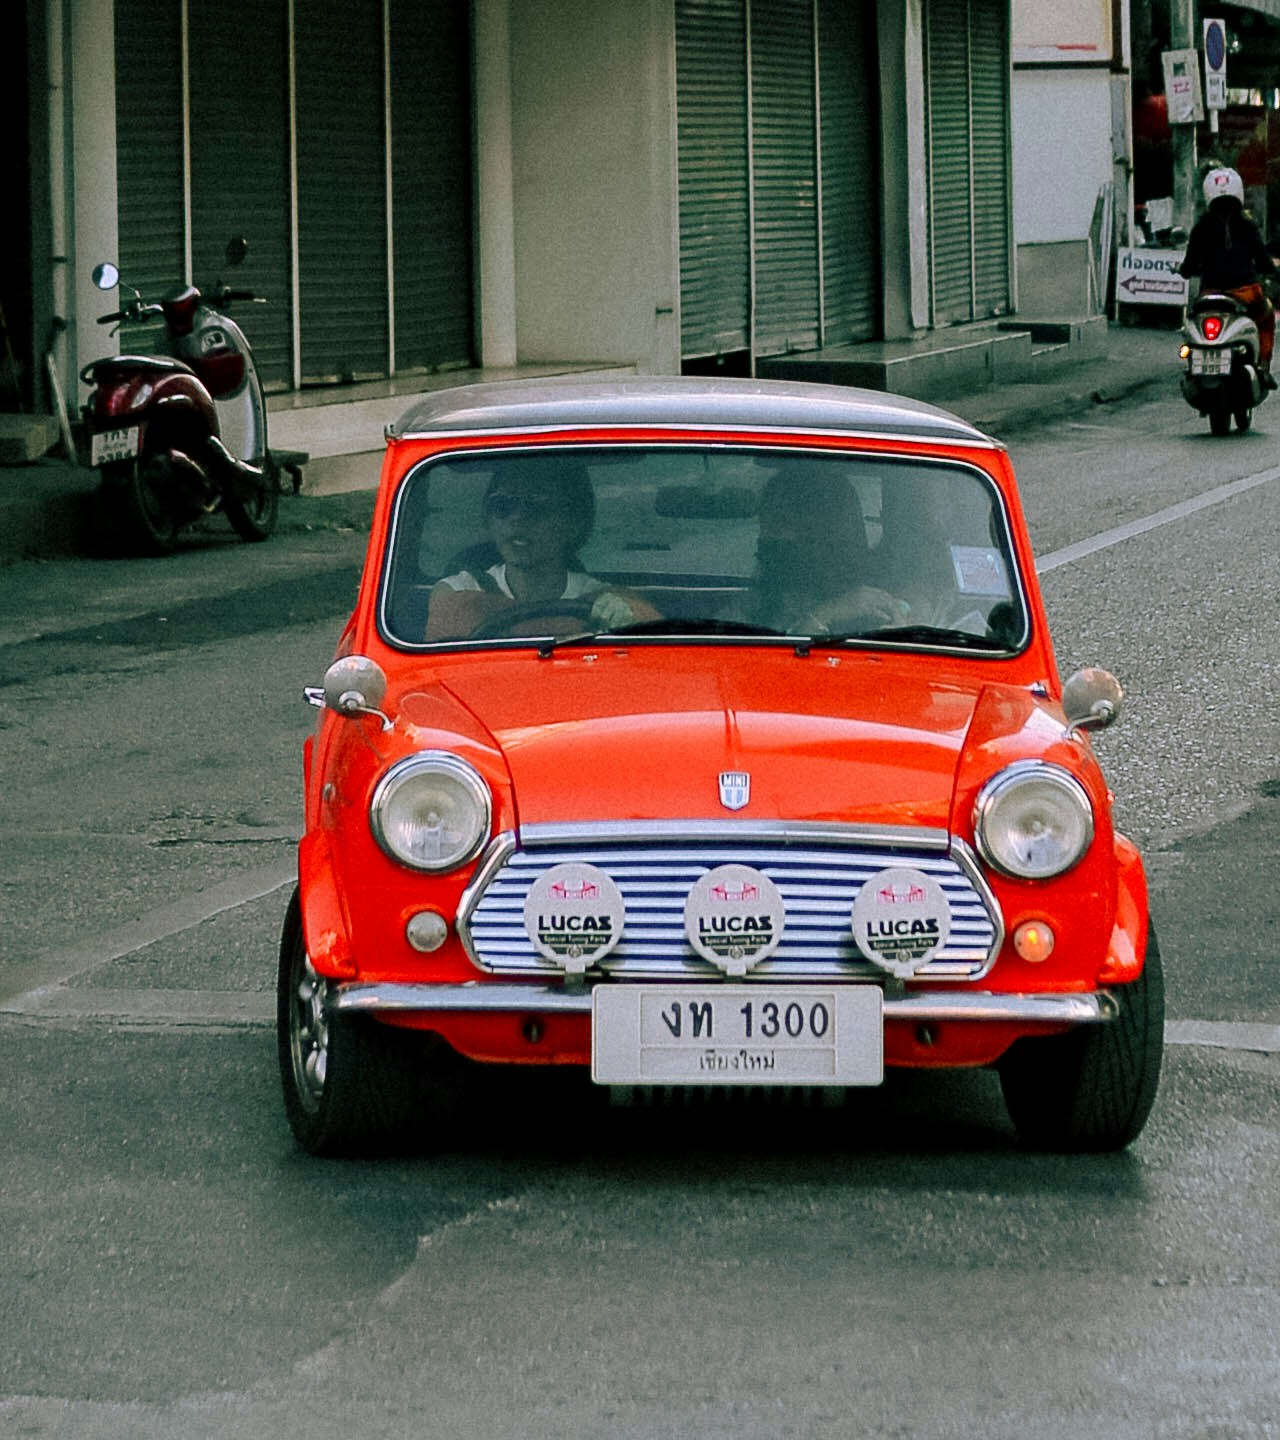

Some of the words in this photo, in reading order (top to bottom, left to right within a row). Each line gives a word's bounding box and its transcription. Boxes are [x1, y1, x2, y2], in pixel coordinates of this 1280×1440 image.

[721, 773, 748, 787] MINI
[538, 915, 612, 931] LUCAS
[699, 916, 772, 932] LUCAS
[867, 919, 939, 936] LUCAS
[662, 1001, 713, 1038] งท
[740, 1001, 829, 1039] 1300
[700, 1048, 775, 1071] เชียงใหม่
